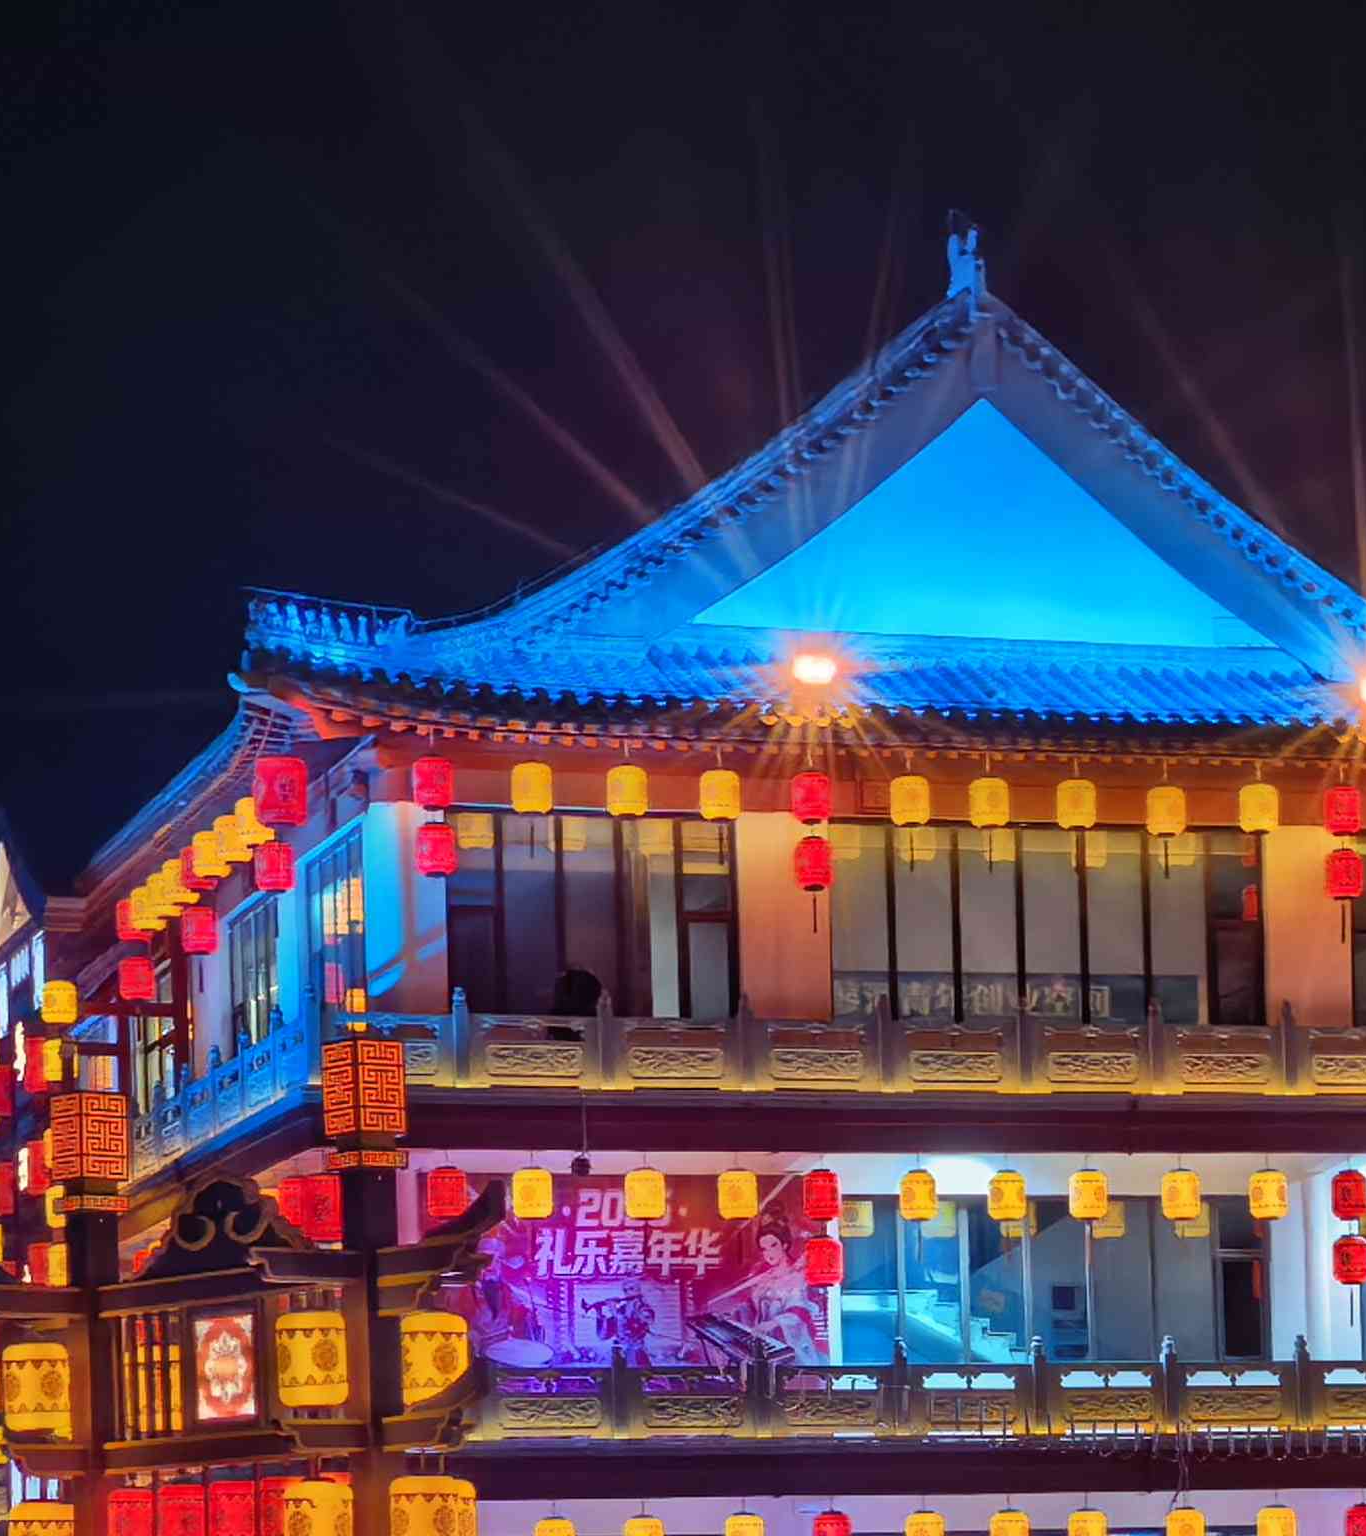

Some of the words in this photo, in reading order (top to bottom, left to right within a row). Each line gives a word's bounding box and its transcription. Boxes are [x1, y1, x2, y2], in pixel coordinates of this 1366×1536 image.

[575, 1189, 672, 1227] 20
[534, 1228, 723, 1279] 礼乐嘉年华
